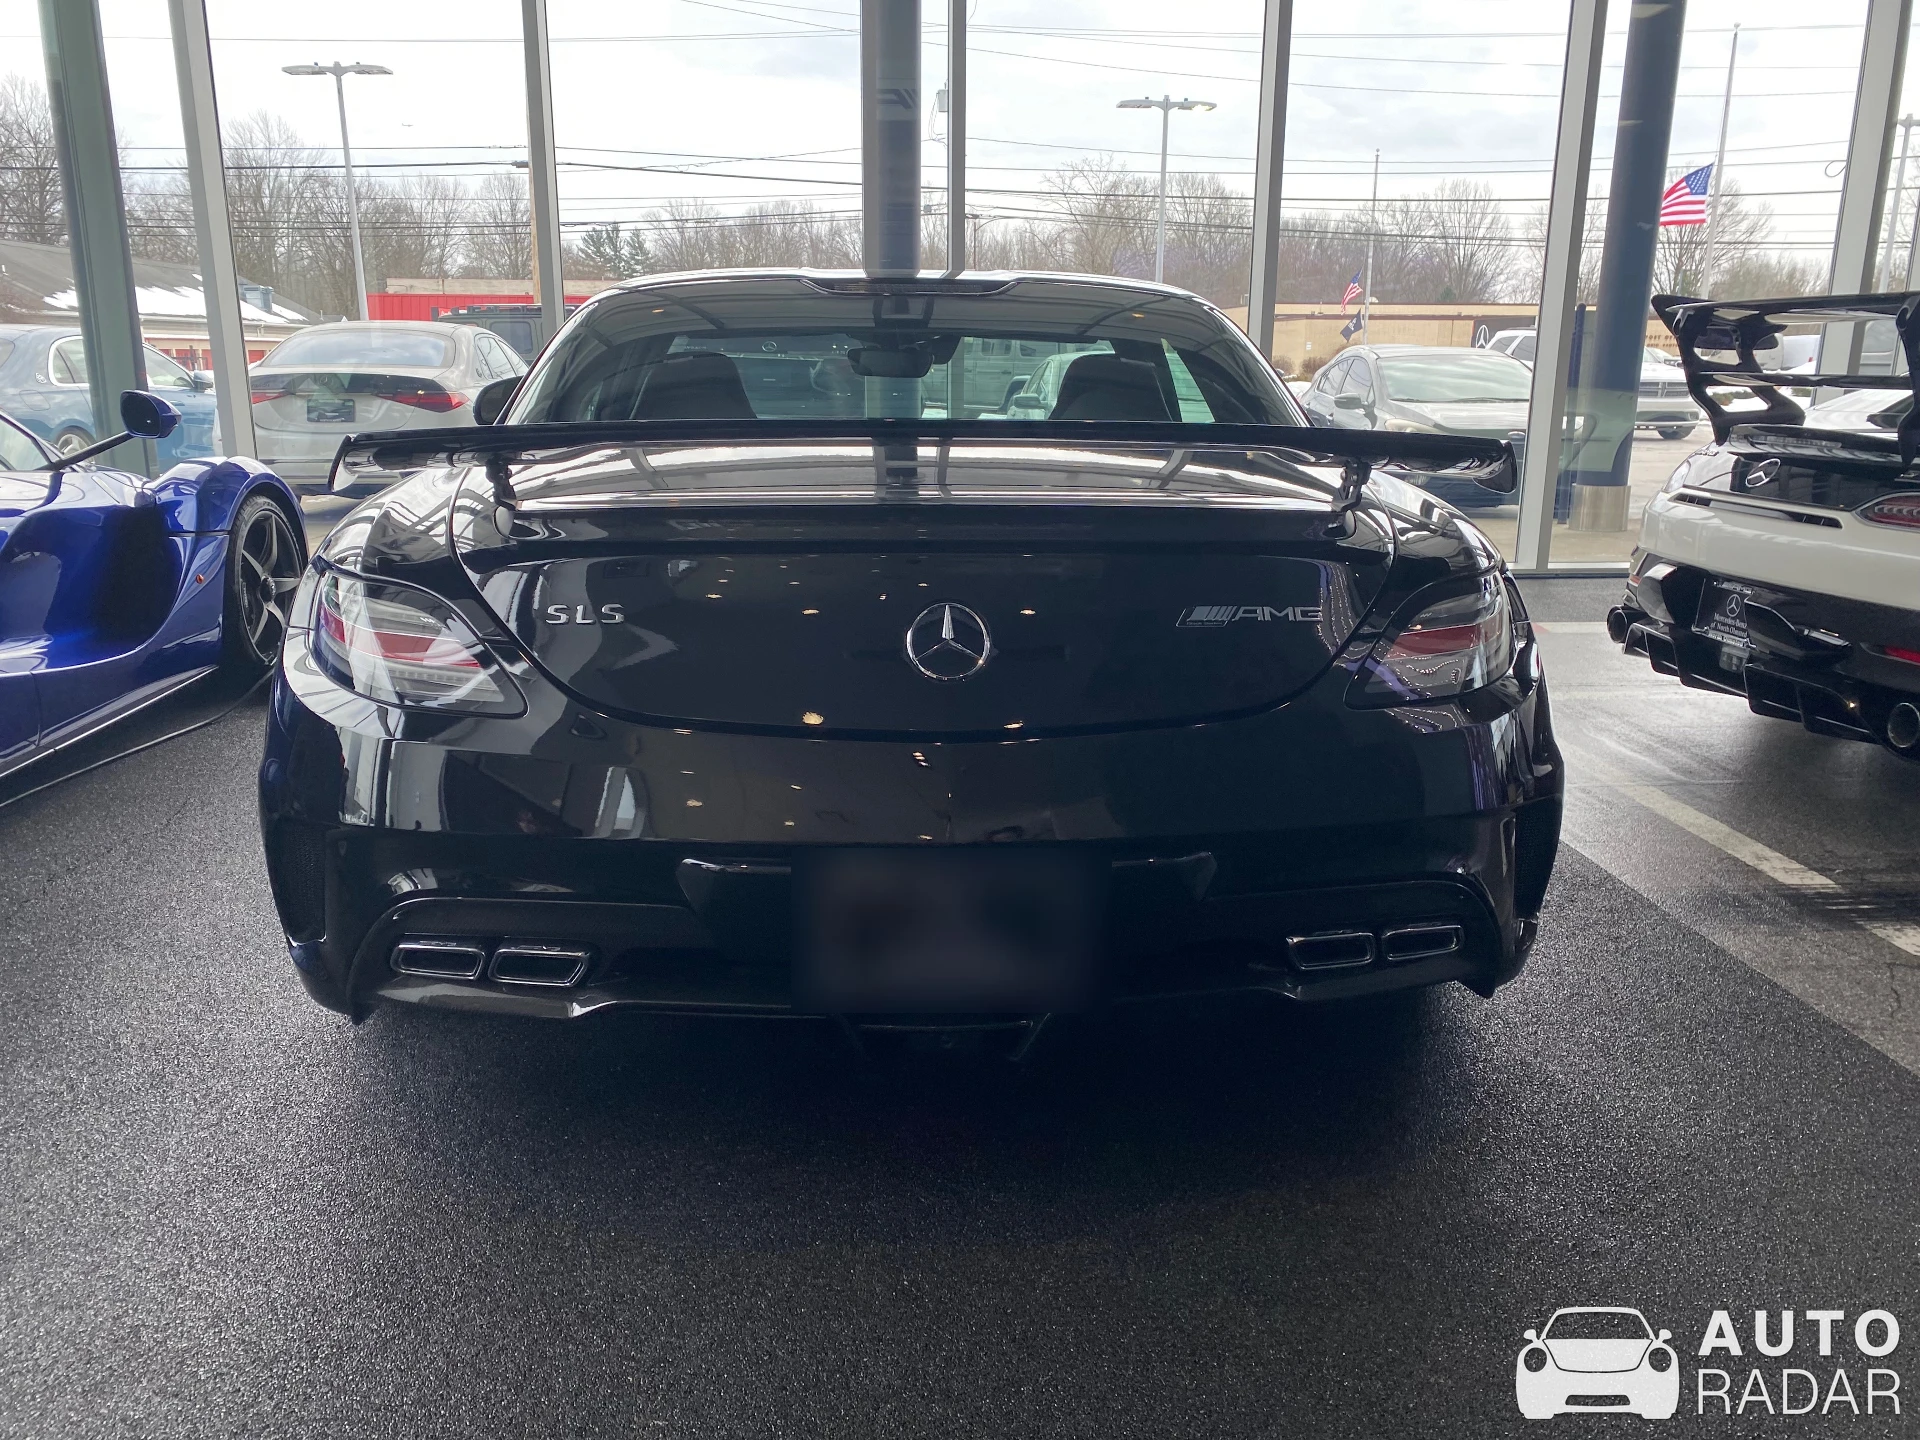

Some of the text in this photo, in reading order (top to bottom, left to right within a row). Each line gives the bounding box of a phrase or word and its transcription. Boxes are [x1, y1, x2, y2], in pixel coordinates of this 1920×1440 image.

[545, 603, 625, 624] SLS
[1232, 606, 1324, 621] AMG
[1713, 612, 1748, 629] Mercedes-Benz
[1730, 626, 1748, 638] Olmsted
